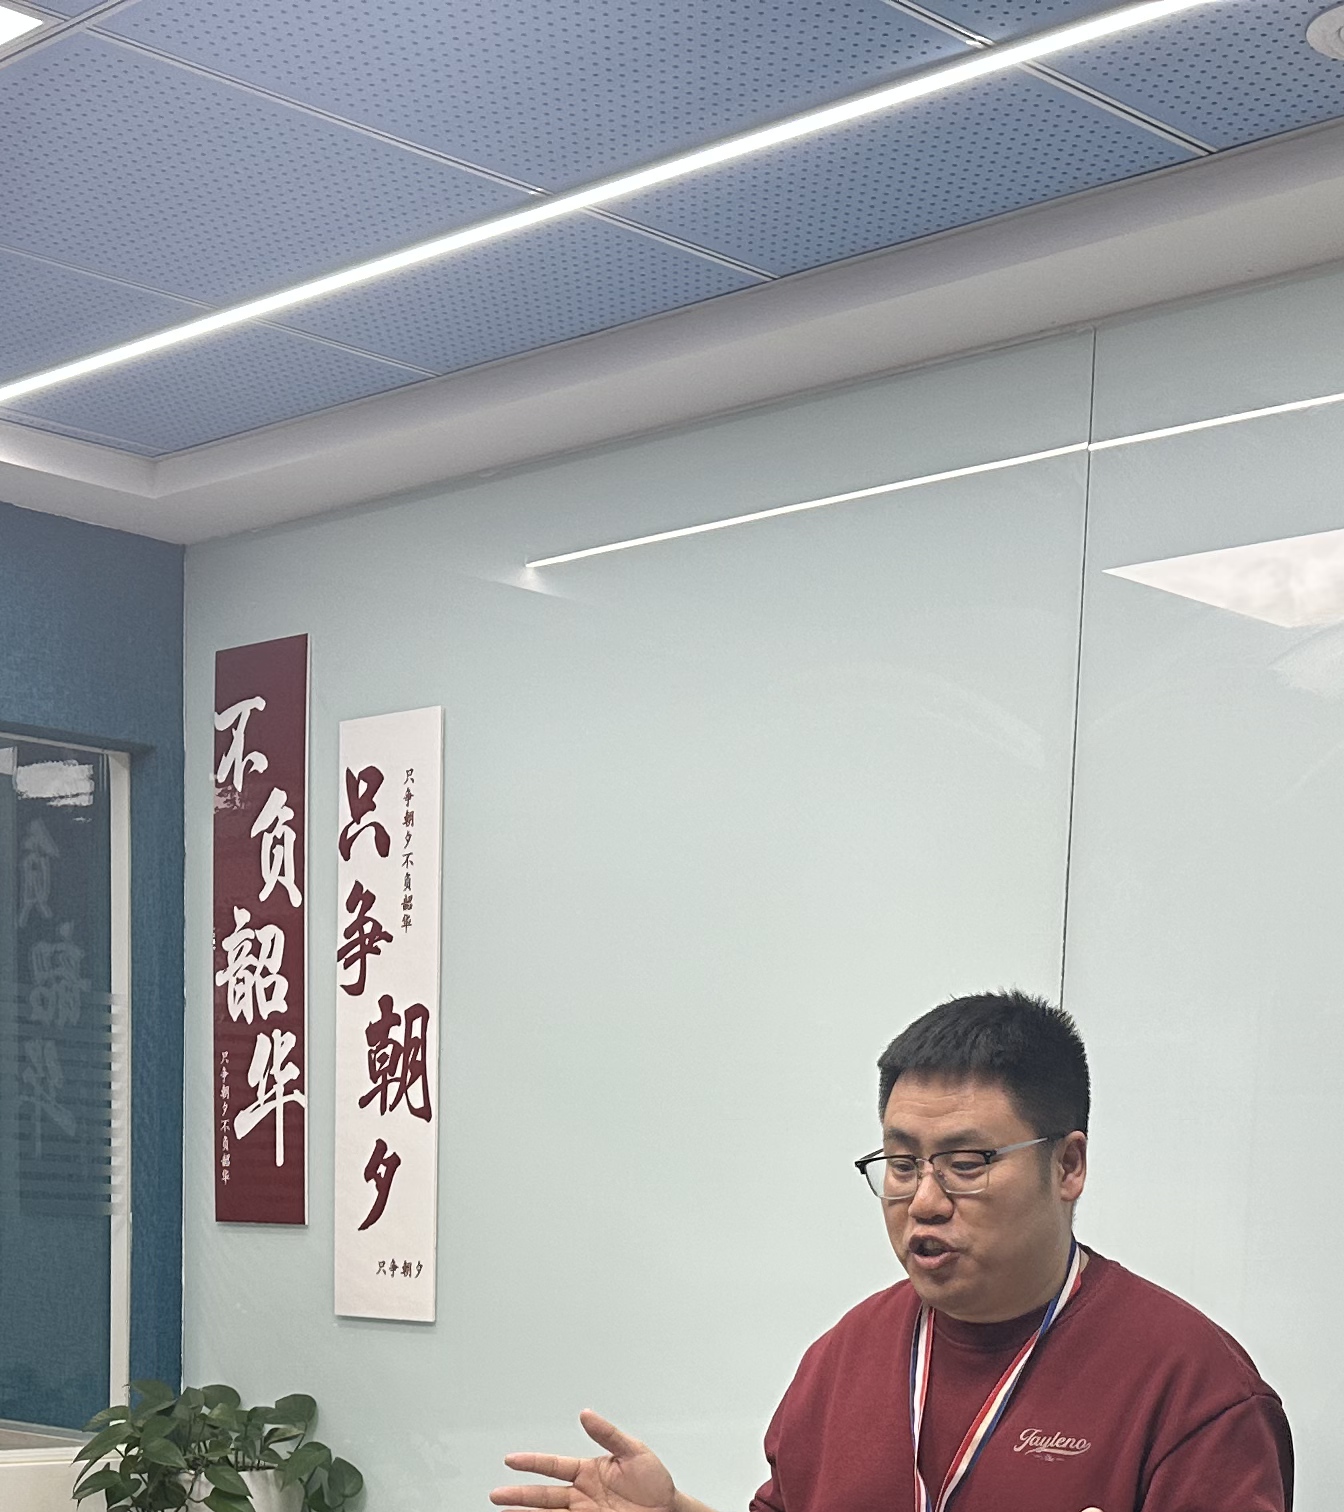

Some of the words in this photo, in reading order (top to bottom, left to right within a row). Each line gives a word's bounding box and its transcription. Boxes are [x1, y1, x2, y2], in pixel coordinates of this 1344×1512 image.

[214, 696, 306, 1167] 不负韶华
[400, 768, 415, 934] 只争朝夕不负韶华
[336, 765, 432, 1232] 只争朝夕
[219, 1050, 232, 1186] 只争朝夕不负韶华
[376, 1259, 424, 1280] 只争朝夕
